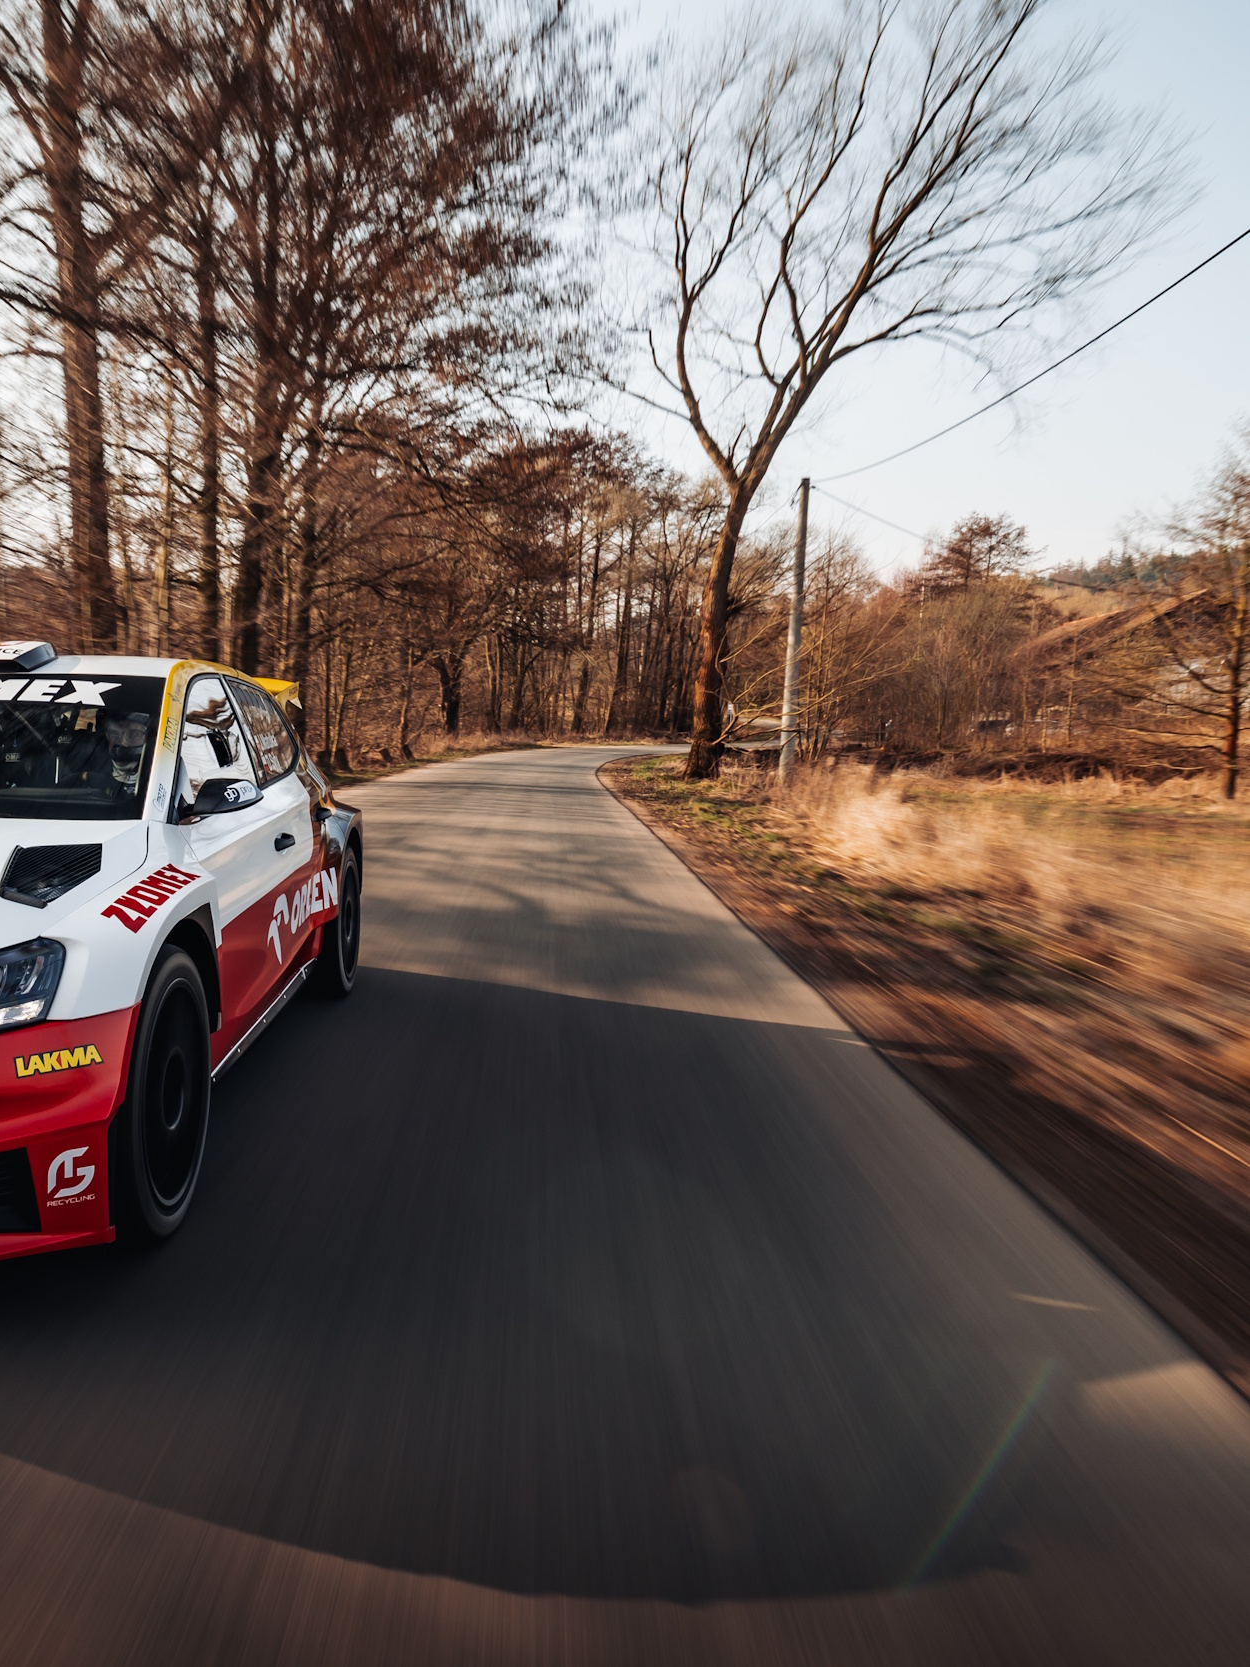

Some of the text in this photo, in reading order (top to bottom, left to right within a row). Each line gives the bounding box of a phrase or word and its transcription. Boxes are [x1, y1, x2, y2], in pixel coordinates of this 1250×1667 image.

[290, 867, 339, 934] ORLEN
[14, 1044, 103, 1078] LAKMA
[46, 1193, 95, 1207] RECYCLING
